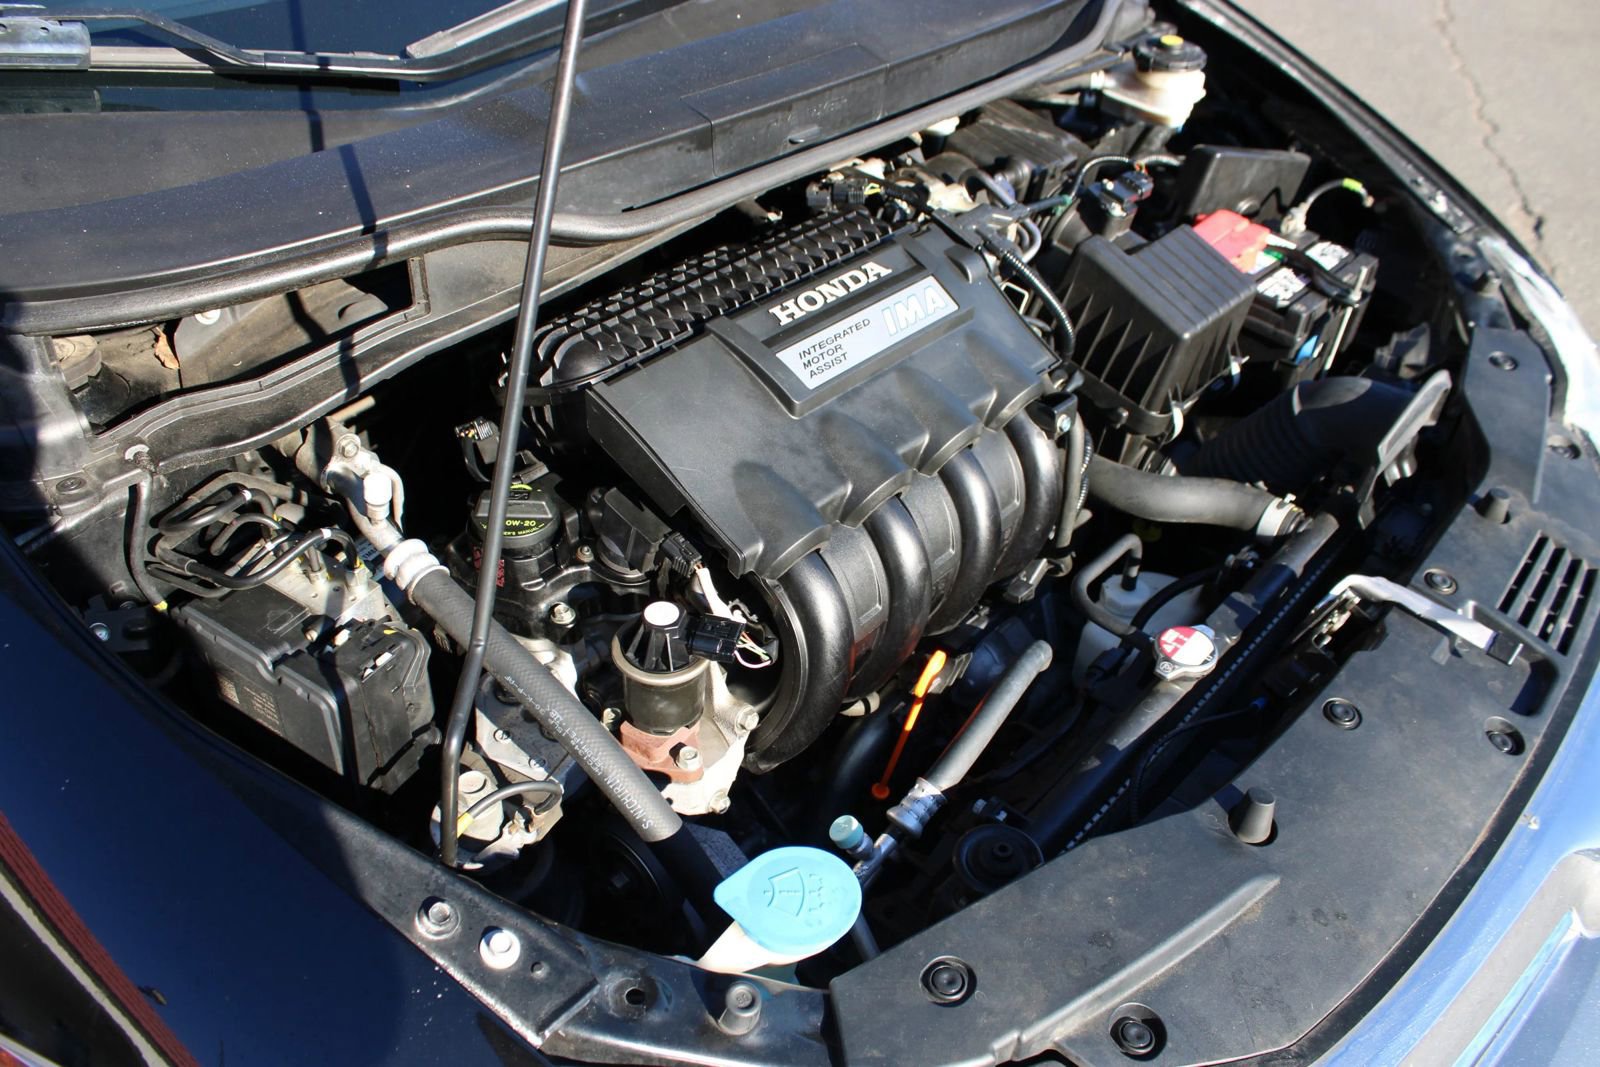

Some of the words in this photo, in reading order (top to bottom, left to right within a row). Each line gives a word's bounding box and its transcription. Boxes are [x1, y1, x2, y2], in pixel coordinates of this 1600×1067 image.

[769, 261, 892, 326] HONDA
[881, 284, 948, 337] IMA
[798, 318, 871, 360] INTEGRATED
[802, 344, 843, 370] MOTOR
[809, 352, 848, 379] ASSIST
